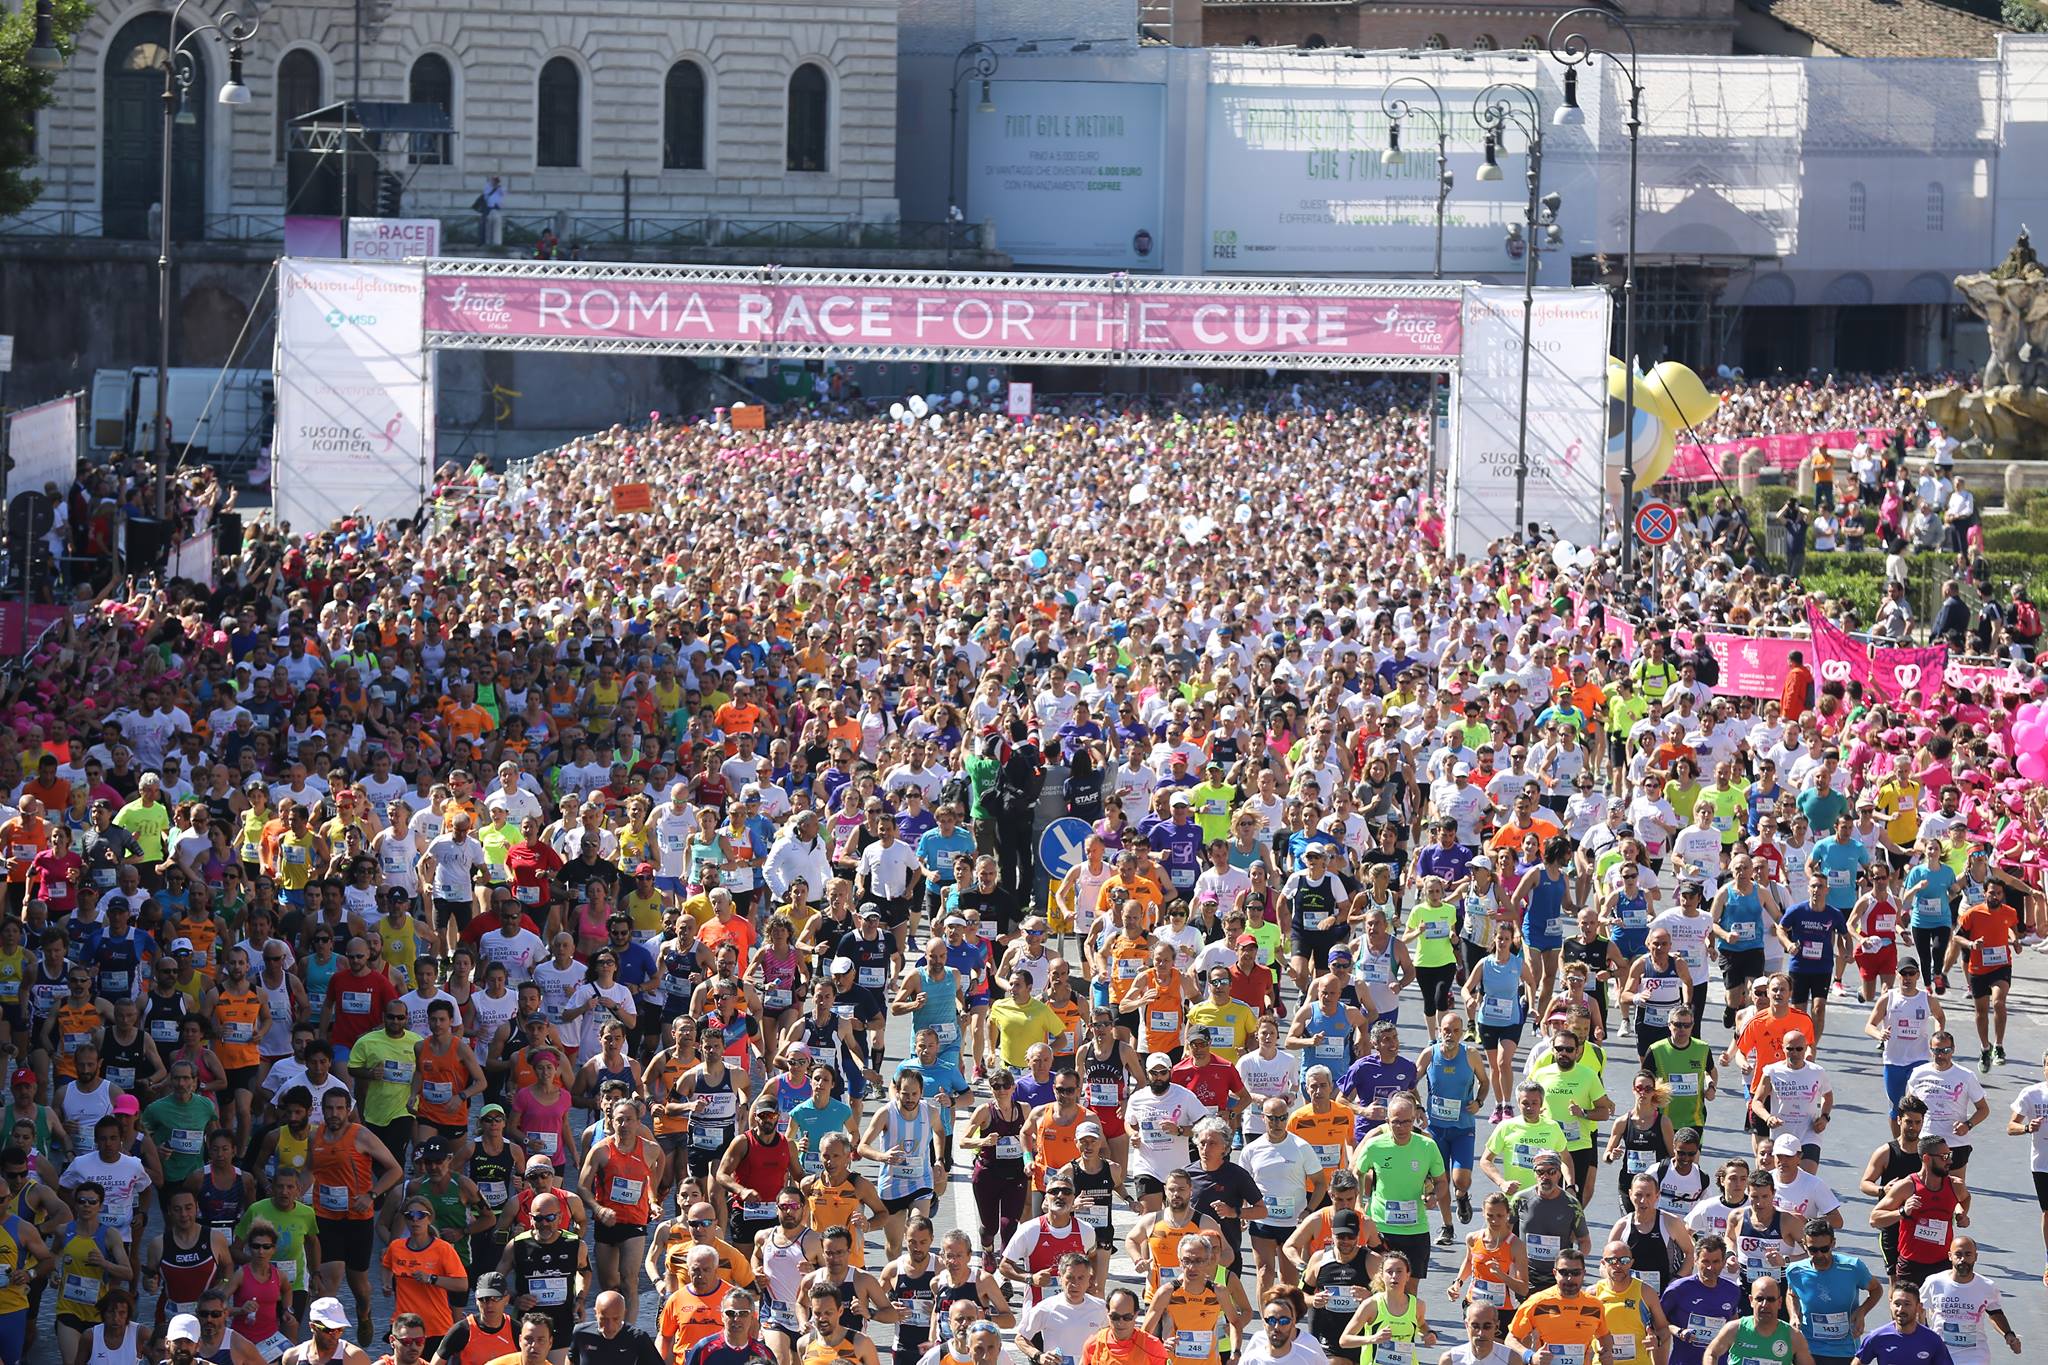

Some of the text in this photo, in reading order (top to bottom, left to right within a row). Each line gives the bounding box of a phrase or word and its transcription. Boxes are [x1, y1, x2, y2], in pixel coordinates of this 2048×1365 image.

[1006, 115, 1031, 138] FIAT
[1075, 115, 1125, 138] METANO
[379, 225, 425, 240] RACE
[354, 241, 425, 257] FOR THE
[1213, 245, 1237, 259] FREE
[464, 296, 506, 312] race
[349, 315, 377, 325] MSD
[538, 287, 1348, 346] ROMA RACE FOR THE CURE
[1396, 318, 1436, 333] race
[300, 426, 349, 438] susan
[312, 439, 371, 452] komen
[1074, 792, 1099, 804] STAFF
[1546, 1087, 1574, 1095] ANDREA
[1519, 1137, 1547, 1145] SERGIO
[1661, 1183, 1678, 1191] BOLD
[1918, 1228, 1939, 1237] 25377
[1534, 1247, 1550, 1255] 1078
[541, 1292, 555, 1300] 817
[1941, 1302, 1975, 1310] FEARLESS
[782, 1313, 794, 1321] 897
[1822, 1325, 1839, 1333] 1433
[1954, 1335, 1968, 1343] 331
[1187, 1344, 1202, 1352] 248
[1387, 1354, 1402, 1363] 488
[1560, 1357, 1574, 1365] 122
